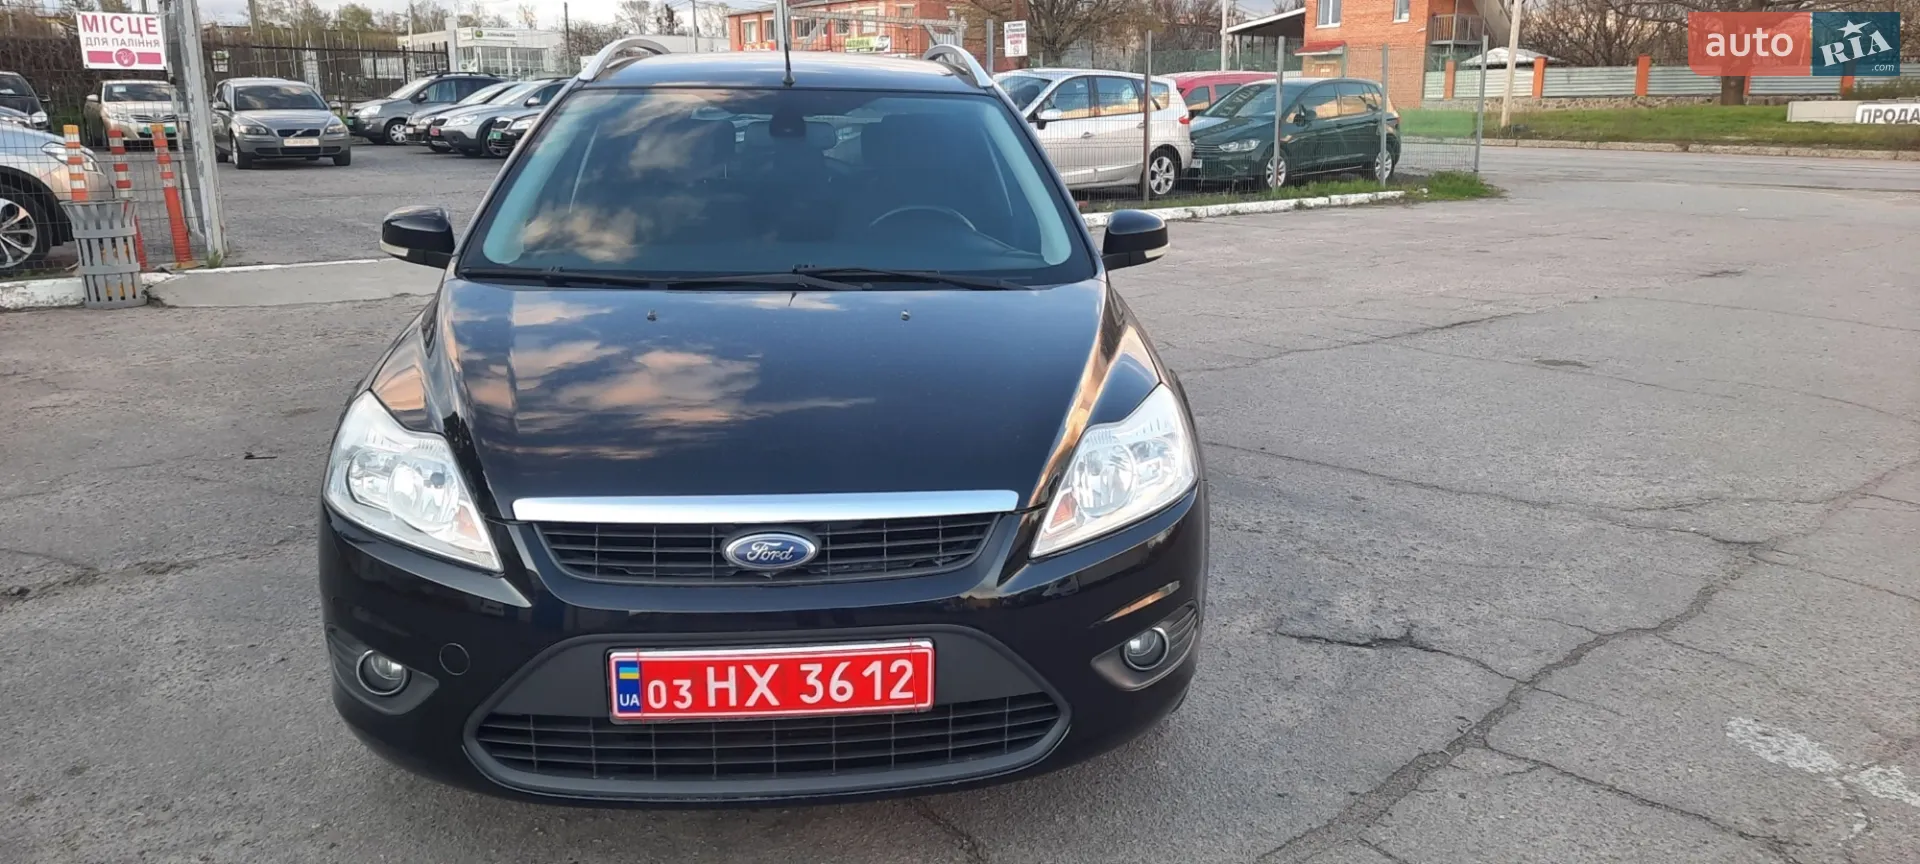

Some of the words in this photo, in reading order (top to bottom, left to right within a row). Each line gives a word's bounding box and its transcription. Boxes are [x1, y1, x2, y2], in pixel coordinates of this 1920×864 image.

[81, 14, 158, 37] МІСЦЕ
[85, 36, 109, 47] ДЛЯ
[111, 37, 161, 48] ПАЛІННЯ
[746, 541, 794, 561] Ford
[619, 694, 640, 707] UA
[647, 679, 693, 709] 03
[706, 664, 780, 708] HX
[799, 658, 914, 704] 3612
